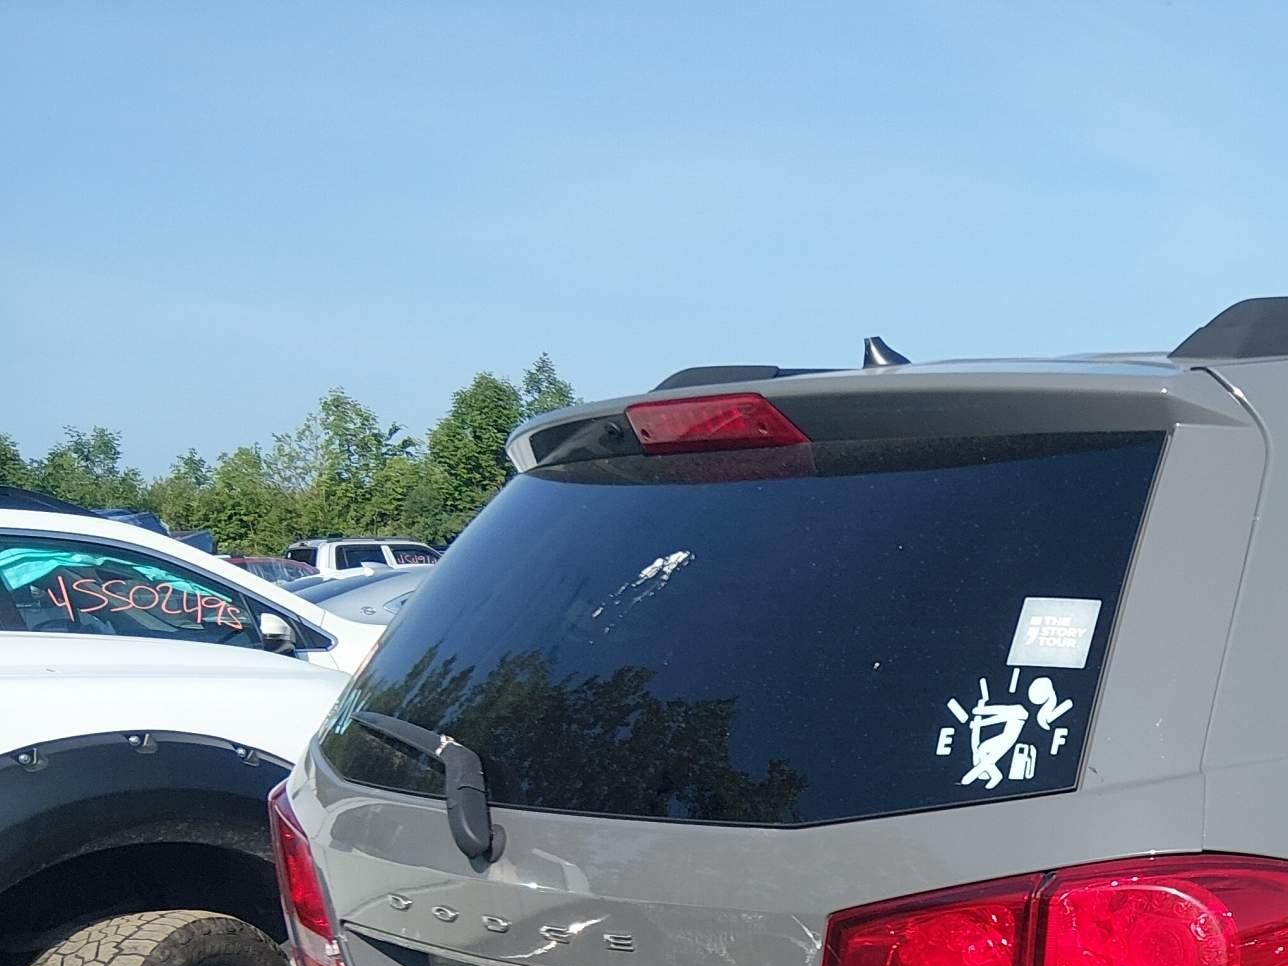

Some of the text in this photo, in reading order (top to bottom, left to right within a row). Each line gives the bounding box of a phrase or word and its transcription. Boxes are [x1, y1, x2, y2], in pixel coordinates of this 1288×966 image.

[47, 575, 243, 631] 45502495
[1040, 627, 1088, 638] STORY
[1044, 616, 1073, 627] THE
[1039, 637, 1077, 648] TOUR
[936, 727, 955, 755] E
[1050, 728, 1068, 755] F
[386, 892, 637, 952] DODGE
